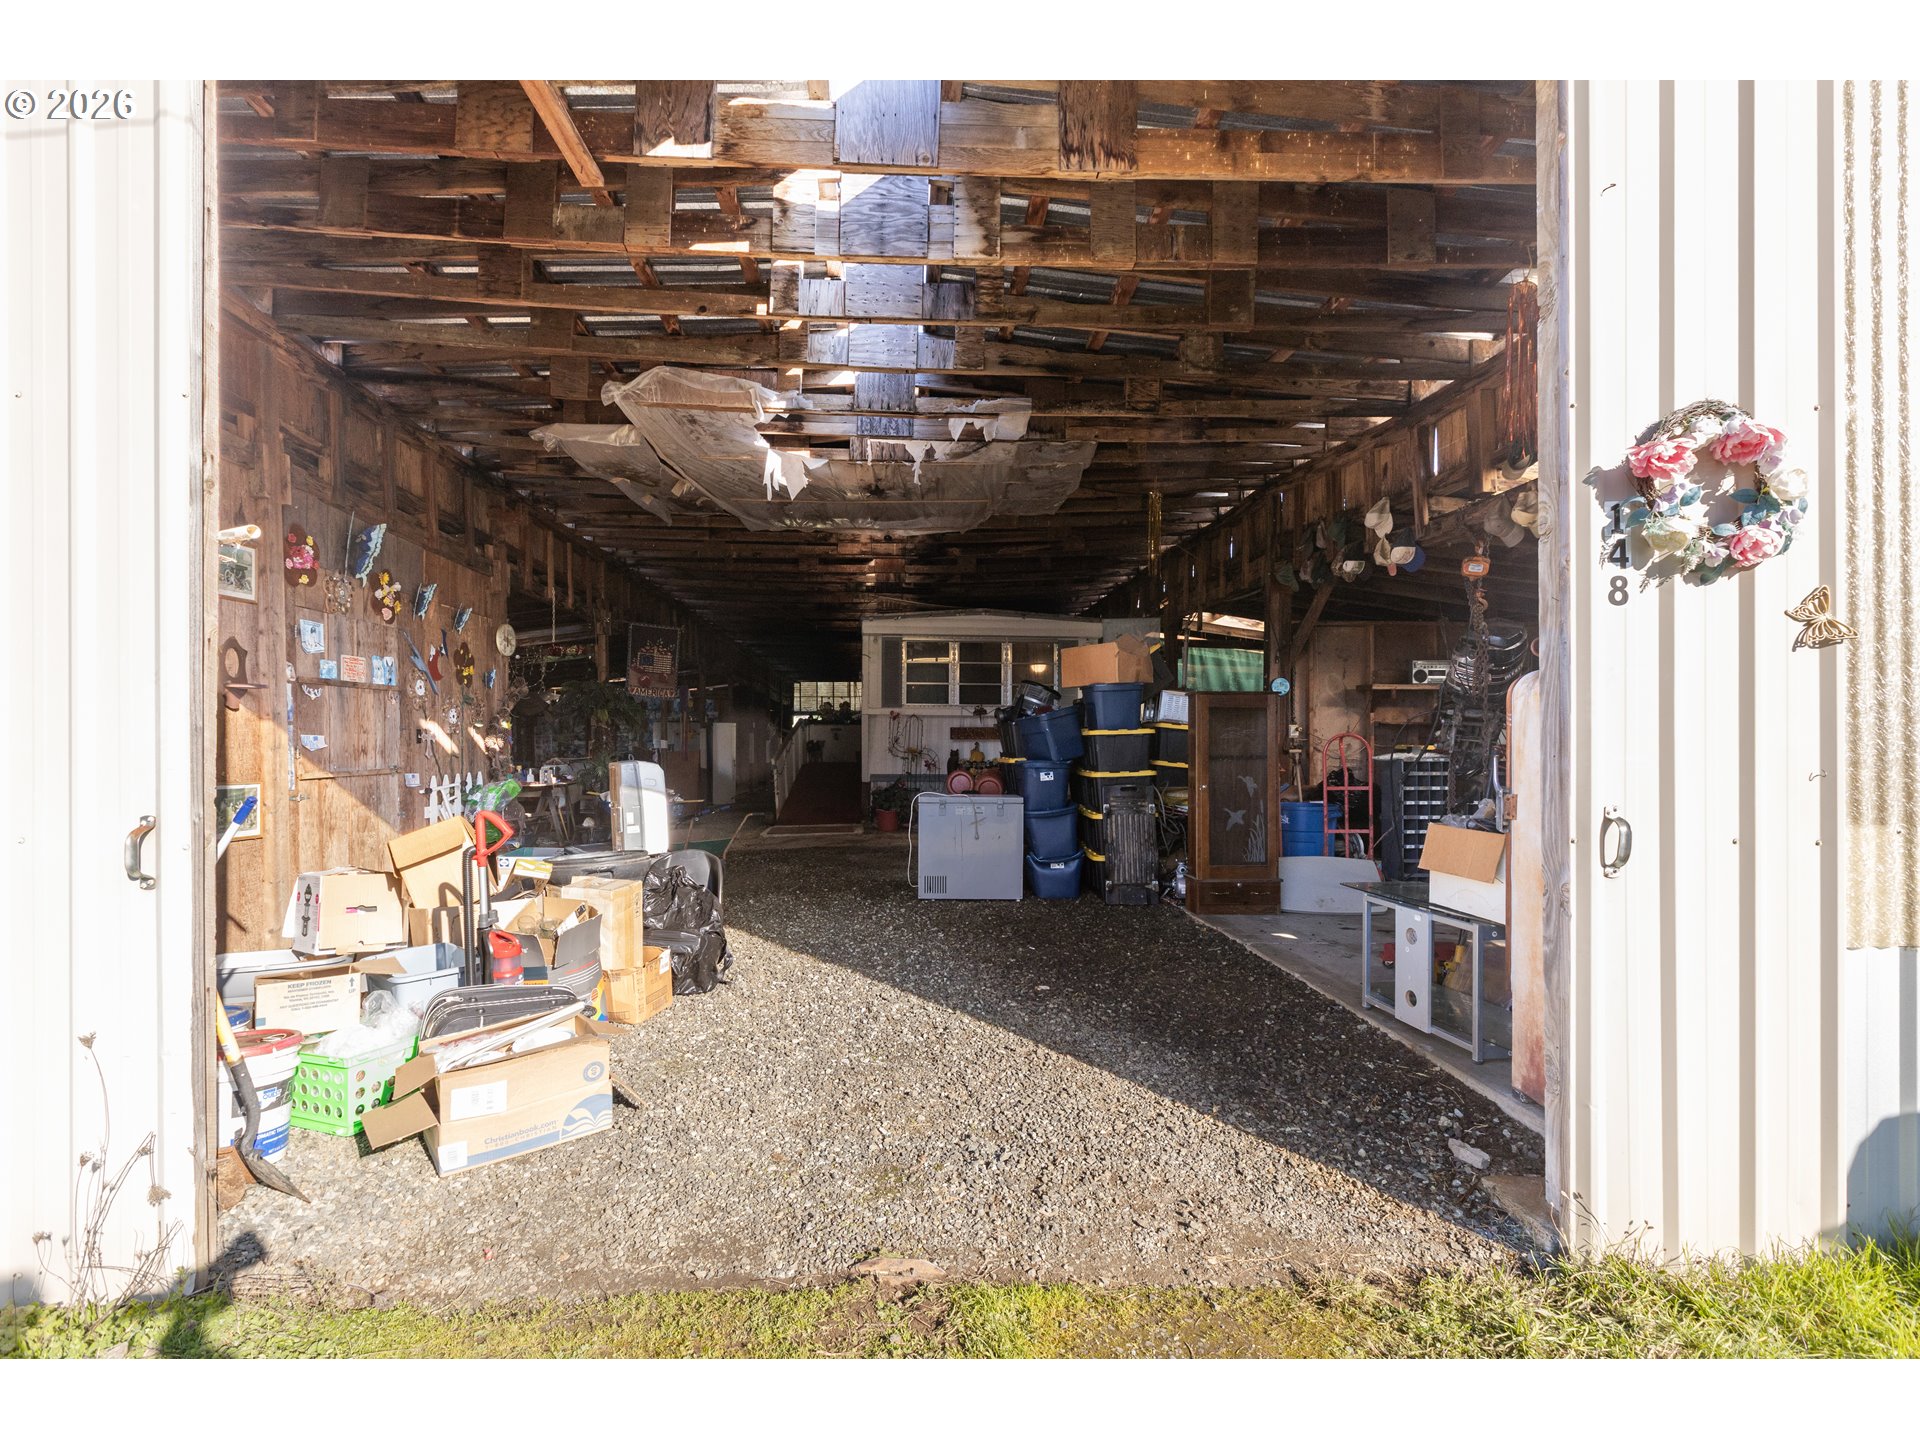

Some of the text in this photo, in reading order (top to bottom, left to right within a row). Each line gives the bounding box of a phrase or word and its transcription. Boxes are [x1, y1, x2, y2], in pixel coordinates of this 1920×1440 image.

[1607, 503, 1629, 606] 148
[634, 687, 669, 698] AMERICA
[306, 979, 332, 987] FROZEN
[484, 1120, 557, 1145] Christianbook.com
